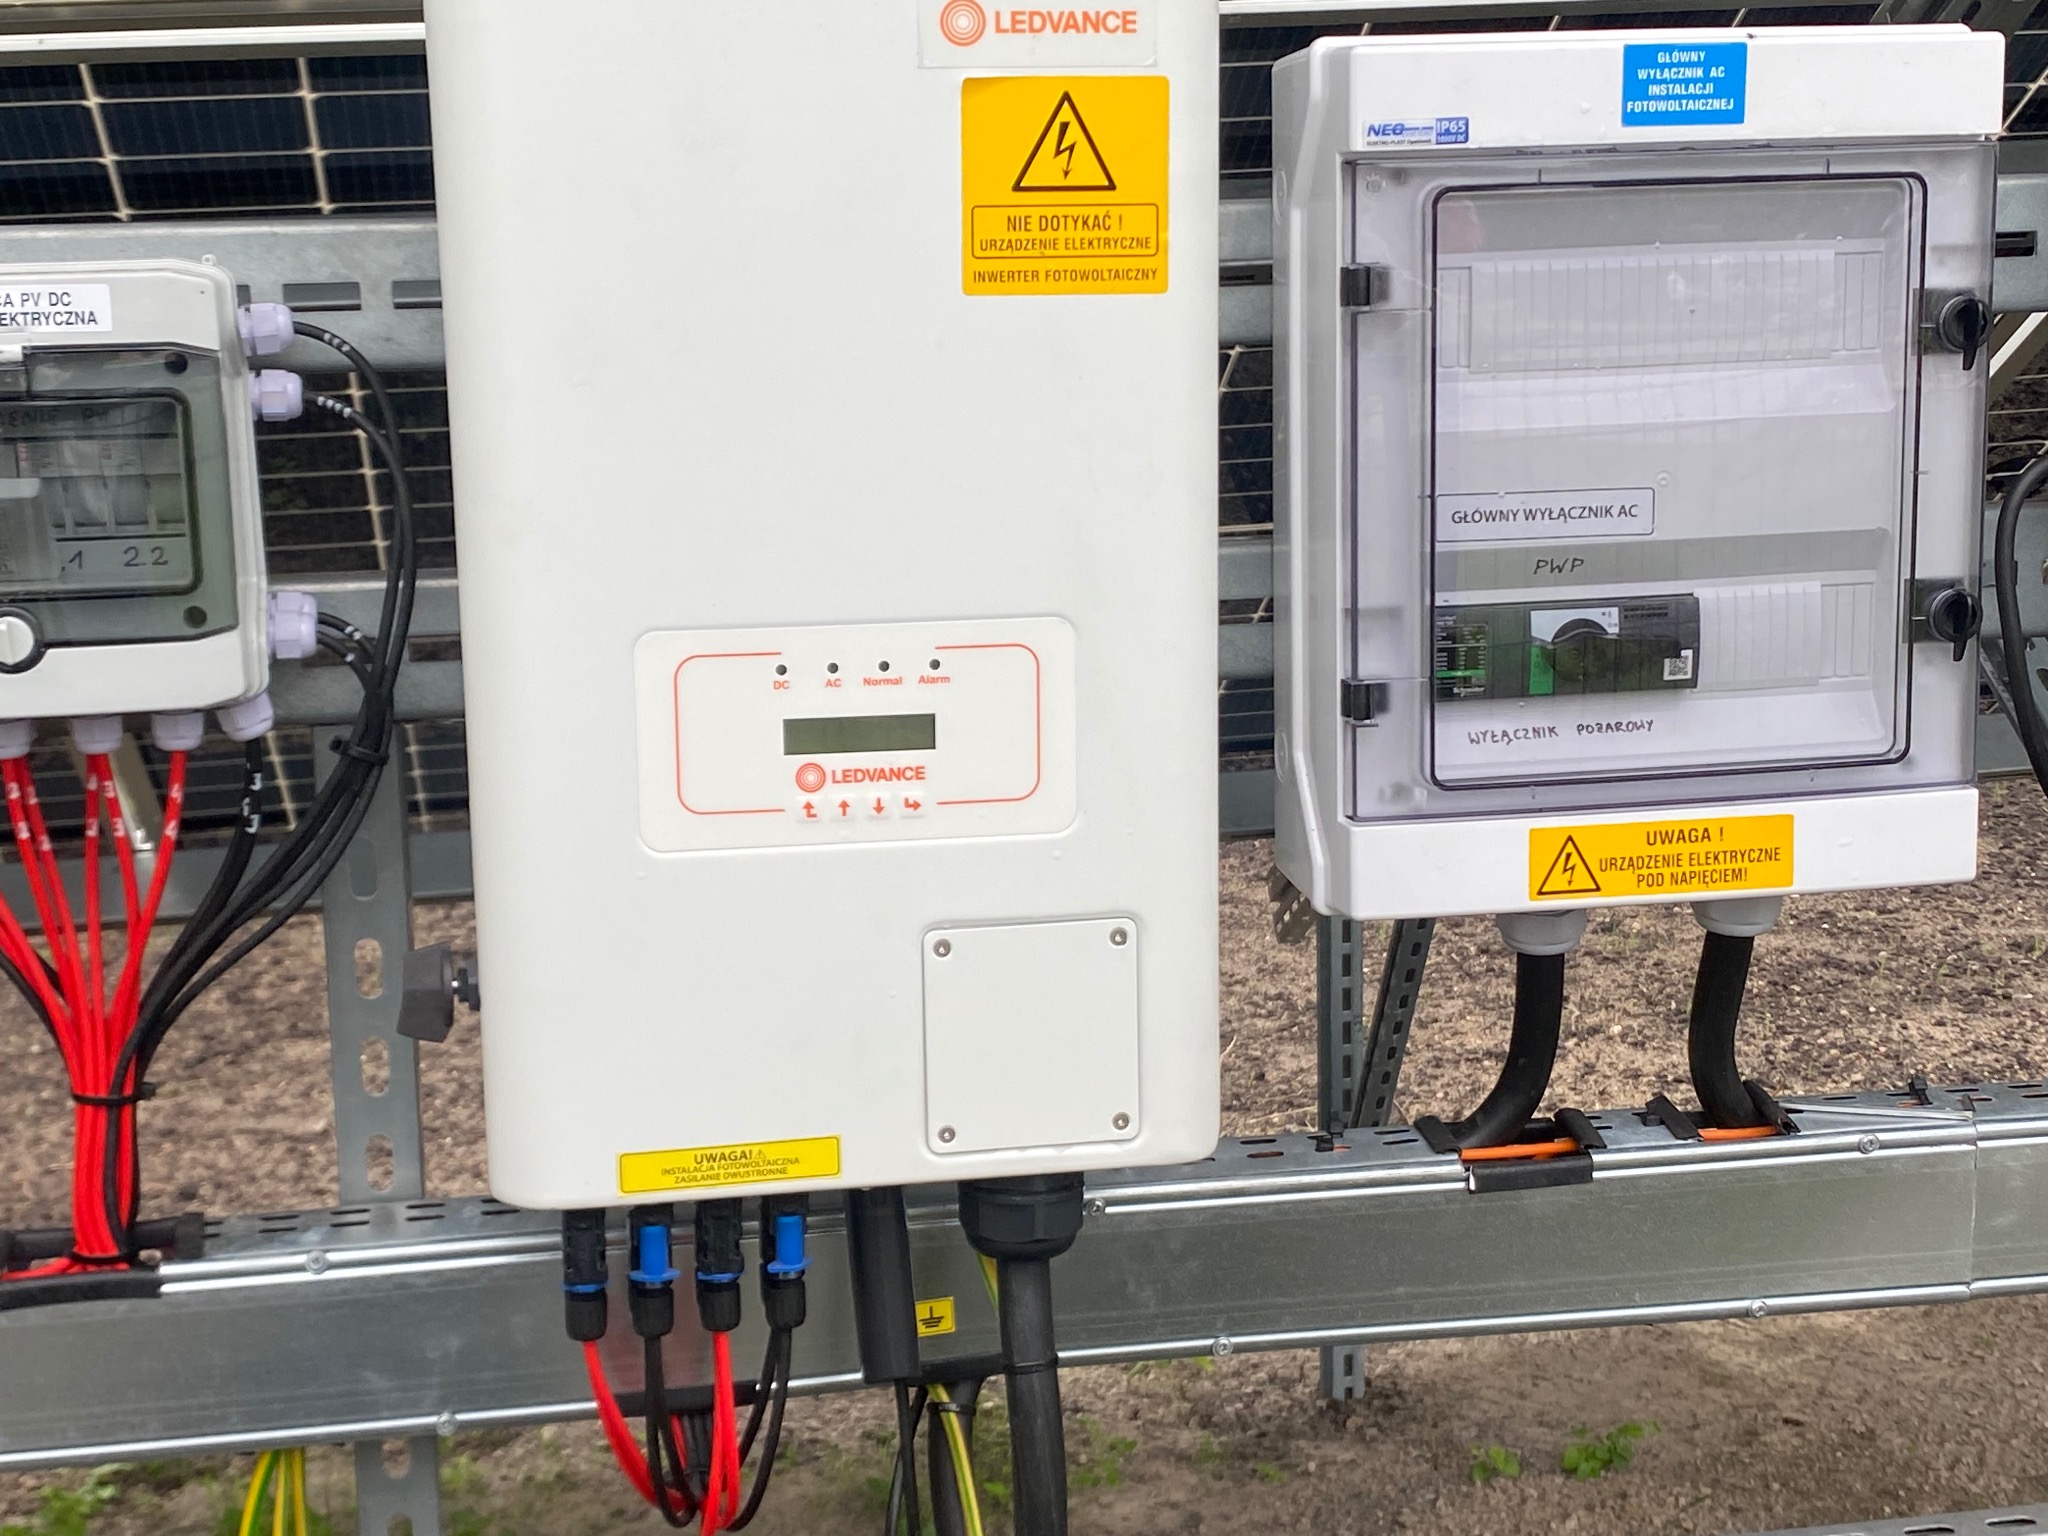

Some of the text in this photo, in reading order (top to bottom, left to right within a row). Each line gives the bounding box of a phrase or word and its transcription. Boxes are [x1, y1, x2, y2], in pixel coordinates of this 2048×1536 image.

[994, 10, 1138, 34] LEDVANCE
[1657, 49, 1706, 64] GŁÓWNY
[1637, 66, 1725, 82] WYŁĄCZNIK AC
[1648, 82, 1714, 97] INSTALACJI
[1626, 97, 1734, 113] FOTOWOLTAICZNEJ
[1366, 122, 1405, 138] NEO
[1437, 119, 1466, 135] IP65
[1006, 209, 1123, 233] NIE DOTYKAĆ !
[979, 236, 1152, 255] URZĄDZENIE ELEKTRYCZNE
[973, 268, 1158, 284] INWERTER FOTOWOLTAICZNY
[20, 292, 41, 307] PV
[48, 291, 72, 307] DC
[1451, 504, 1639, 524] GŁÓWNY WYŁĄCZNIK AC
[1533, 557, 1585, 575] PWP
[773, 681, 790, 690] DC
[825, 679, 842, 688] AC
[863, 676, 903, 686] Normal
[918, 675, 950, 684] Alarm
[1468, 725, 1559, 745] WYŁĄCZNIK
[831, 765, 926, 784] LEDVANCE
[1646, 827, 1724, 846] UWAGA !
[1600, 847, 1781, 874] URZĄDZENIE ELEKTRYCZNE
[1637, 867, 1747, 888] POD NAPIĘCIEM!
[694, 1149, 753, 1164] UWAGA!
[661, 1157, 799, 1176] INSTALACJA FOTOWOLTAICZNA
[674, 1167, 788, 1184] ZASILANIE DWUSTRONNE
